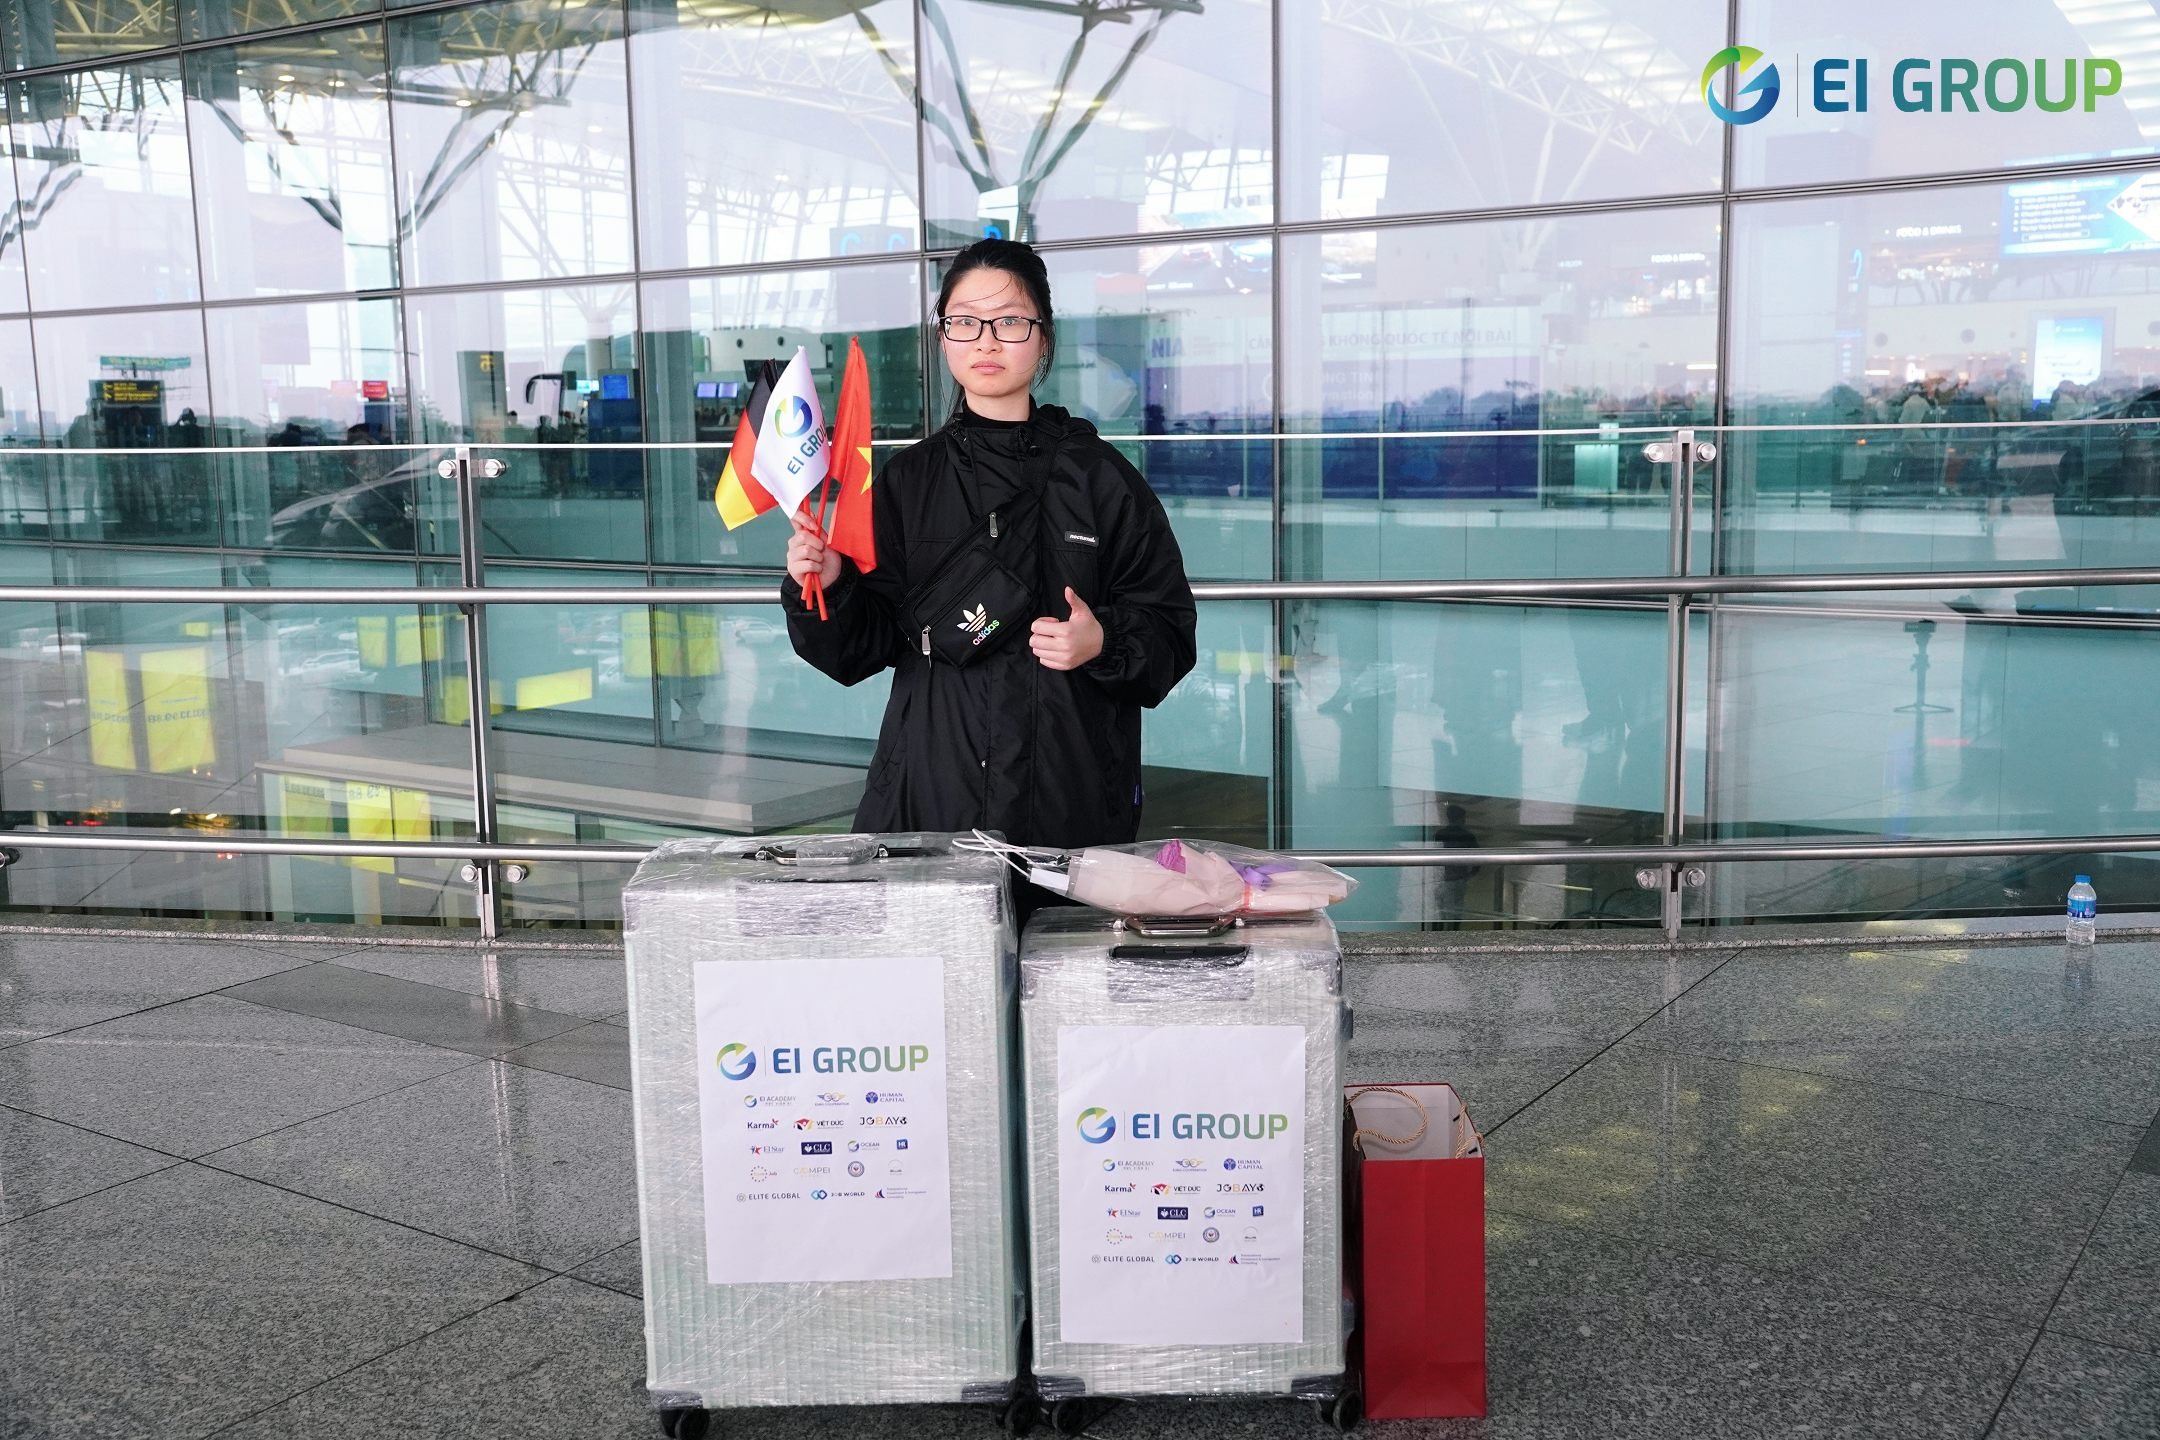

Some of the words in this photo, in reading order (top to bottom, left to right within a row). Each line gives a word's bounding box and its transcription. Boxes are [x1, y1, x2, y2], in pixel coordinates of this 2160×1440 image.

[787, 456, 805, 475] EI
[972, 619, 1000, 646] adidas
[773, 1047, 801, 1074] EI
[813, 1045, 929, 1073] GROUP
[747, 1121, 775, 1129] Karma
[1132, 1113, 1160, 1139] EI
[1172, 1113, 1289, 1140] GROUP
[771, 1192, 801, 1200] GLOBAL
[1104, 1185, 1132, 1193] Karma
